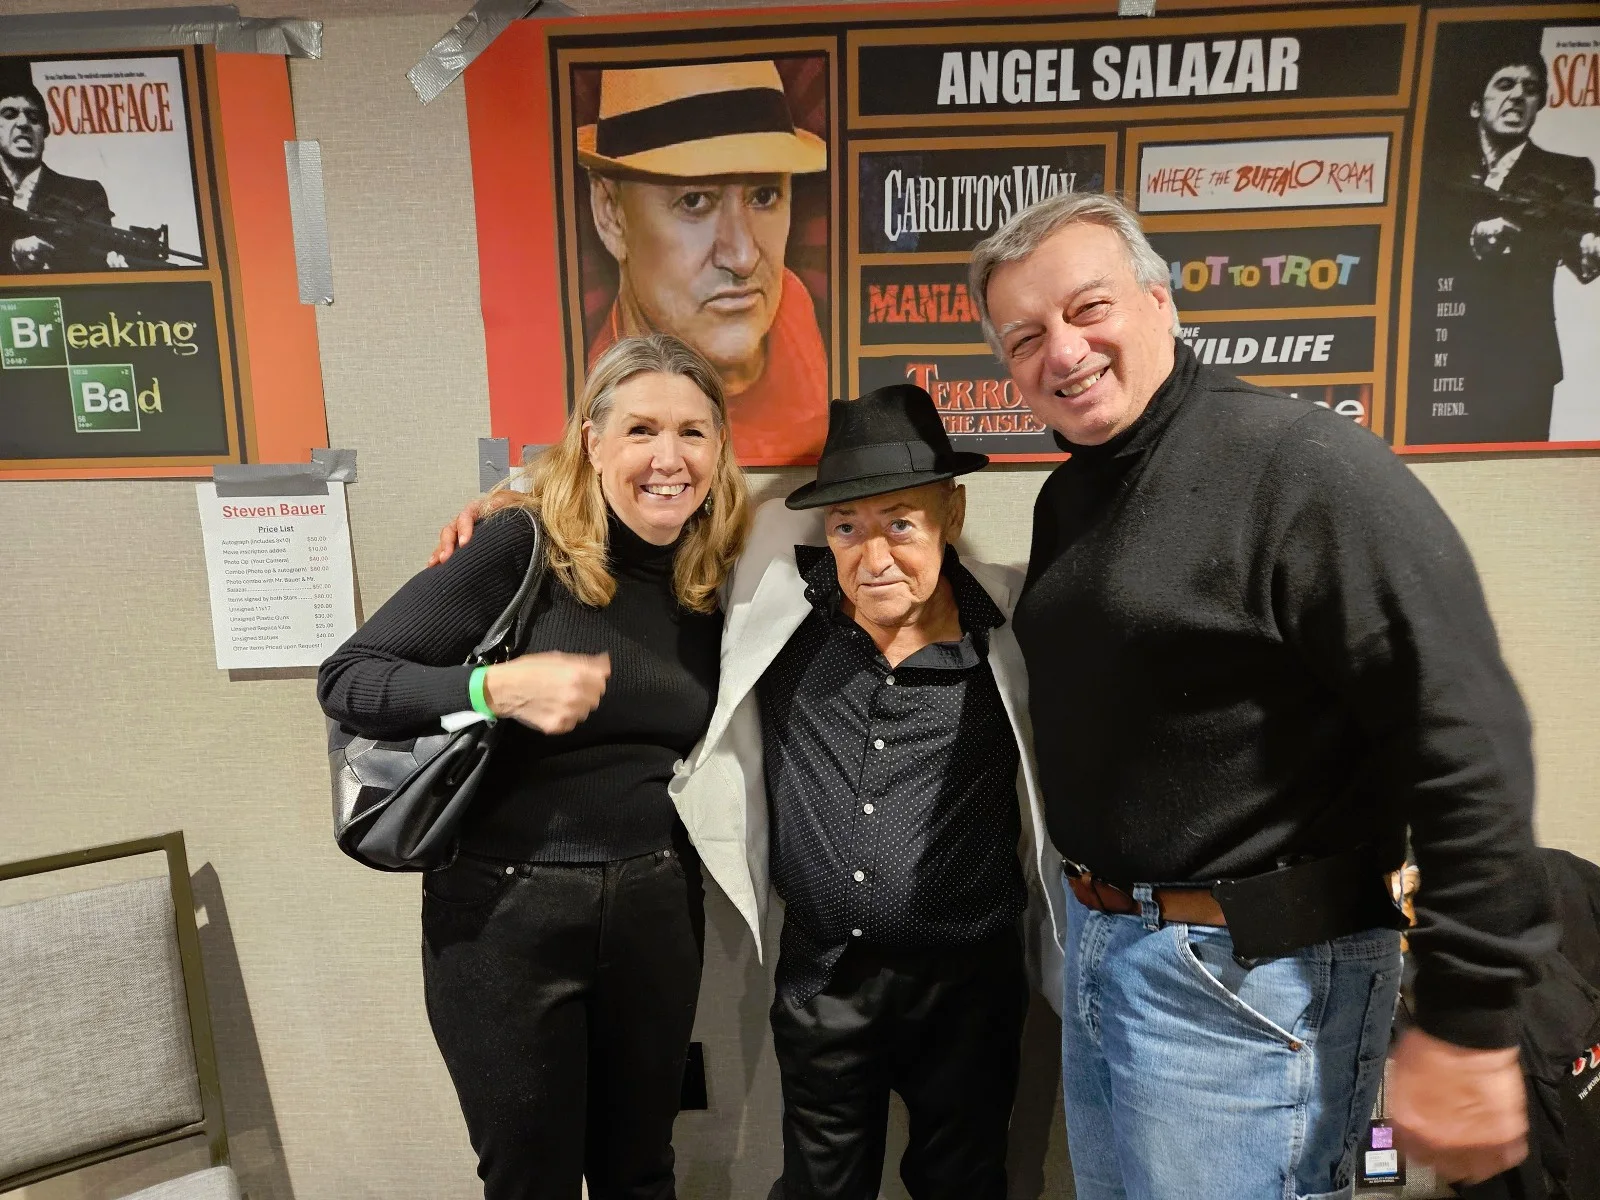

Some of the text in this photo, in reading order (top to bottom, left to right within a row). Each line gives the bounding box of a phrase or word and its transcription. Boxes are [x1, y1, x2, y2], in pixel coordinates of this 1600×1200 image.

[937, 37, 1300, 105] ANGEL SALAZAR
[1550, 52, 1600, 108] SCA
[47, 82, 173, 136] SCARFACE
[1147, 159, 1375, 197] WHERE THE BUFFALO ROAM
[884, 169, 1011, 242] CARLITO'S
[1228, 265, 1261, 287] TO
[1262, 254, 1361, 290] TROT
[1437, 278, 1454, 292] SAY
[868, 284, 980, 323] MANIA
[1436, 302, 1466, 317] HELLO
[1261, 334, 1335, 363] LIFE
[1435, 328, 1448, 342] TO
[1433, 353, 1448, 367] MY
[81, 377, 163, 414] Bad
[905, 363, 1029, 411] TERRO
[1433, 377, 1464, 392] LITTLE
[223, 504, 325, 517] Steven Bauer
